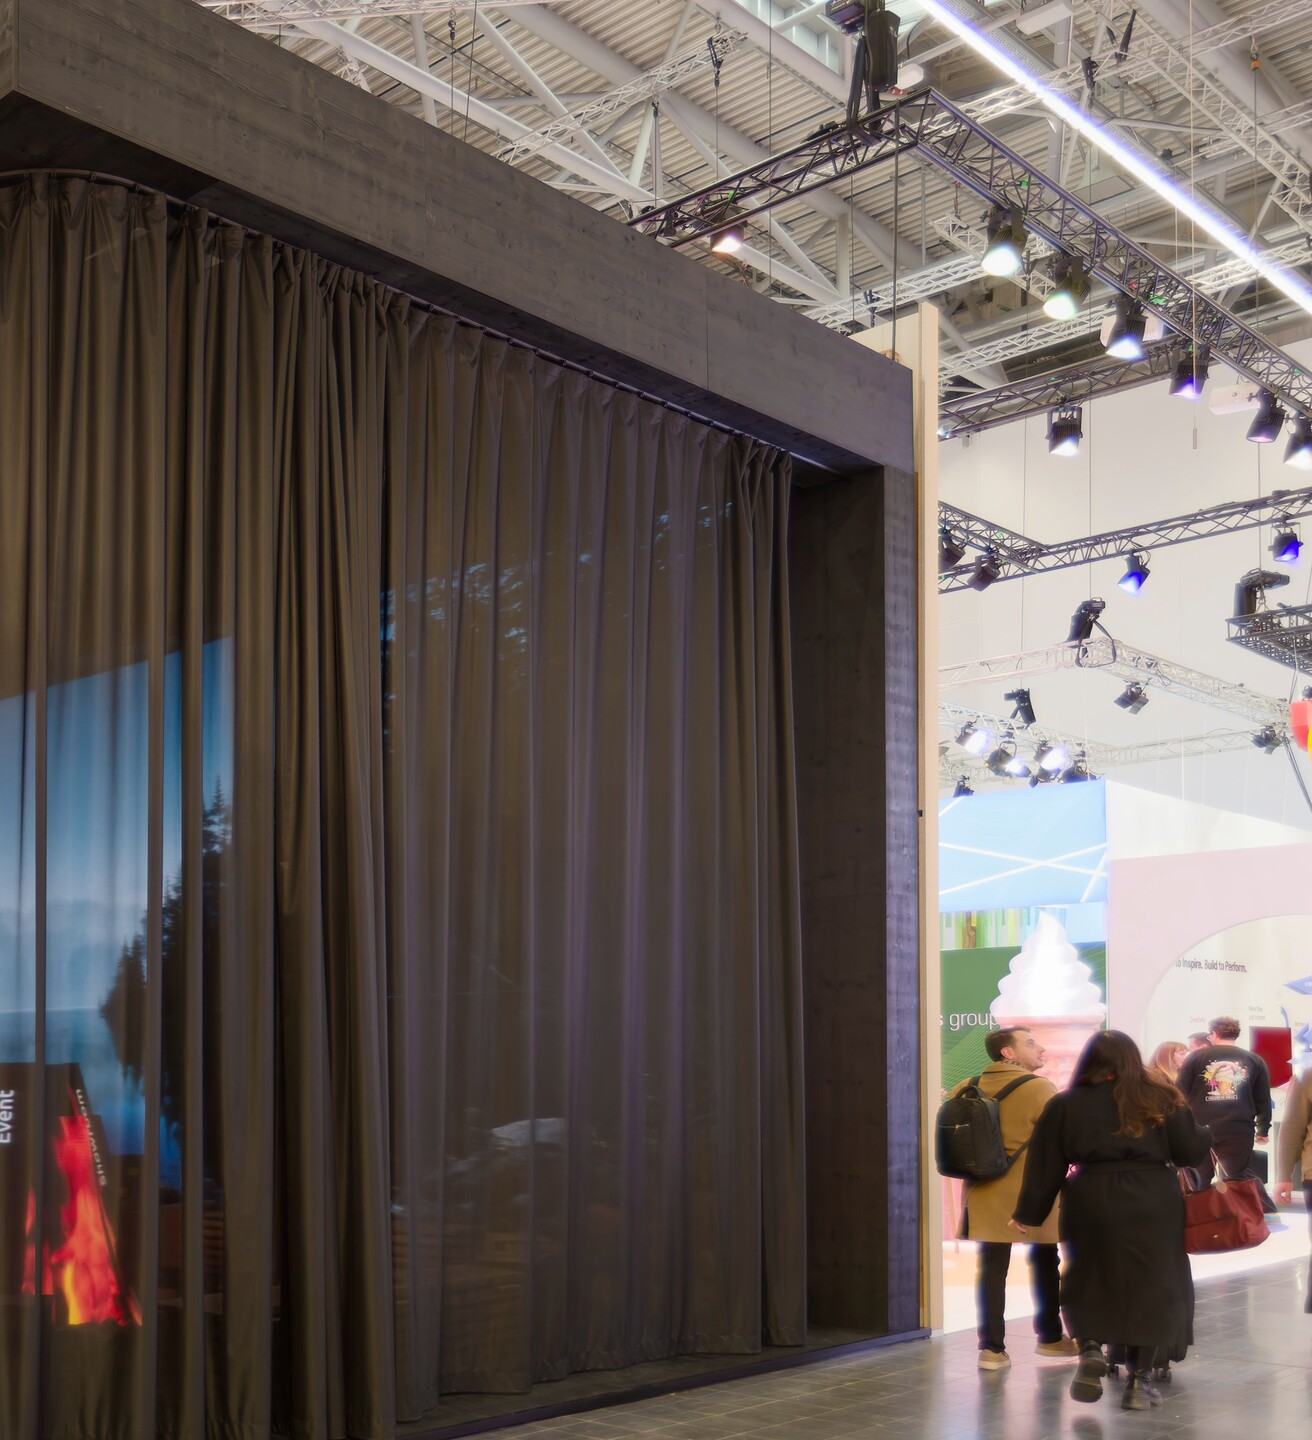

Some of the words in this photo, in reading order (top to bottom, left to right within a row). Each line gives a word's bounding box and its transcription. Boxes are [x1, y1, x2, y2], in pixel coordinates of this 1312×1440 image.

[1183, 958, 1203, 970] Inspire.
[1204, 959, 1218, 971] Build
[1218, 961, 1225, 971] to
[1225, 961, 1248, 973] Perform.
